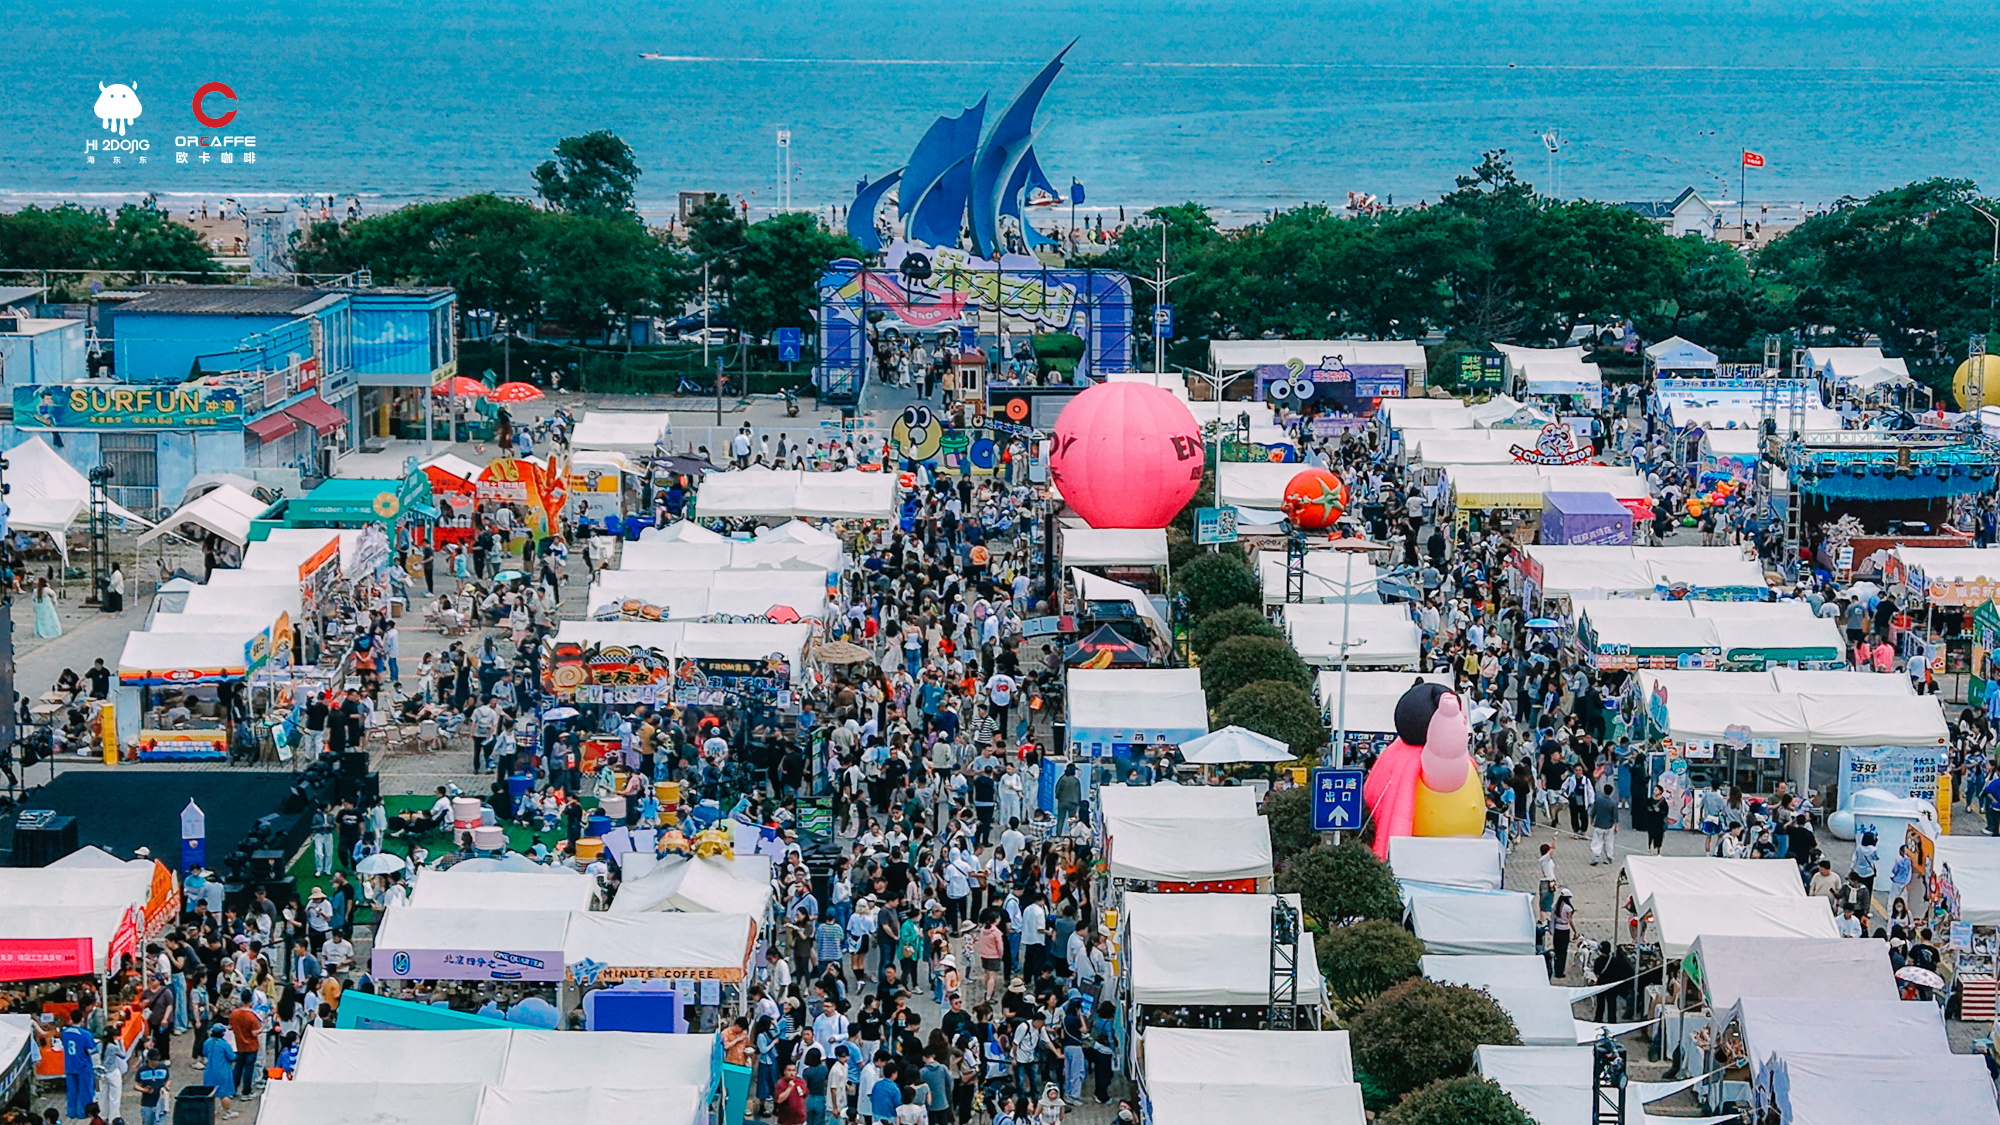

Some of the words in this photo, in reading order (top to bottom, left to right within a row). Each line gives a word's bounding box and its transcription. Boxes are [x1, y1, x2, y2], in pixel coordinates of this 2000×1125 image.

[69, 389, 200, 413] SURFUN
[1322, 778, 1357, 790] 海口路
[1325, 791, 1351, 803] 出口
[443, 954, 508, 969] 北京四分之一
[509, 954, 545, 969] QUARTER
[603, 970, 654, 979] MINUTE
[664, 970, 714, 979] COFFEE
